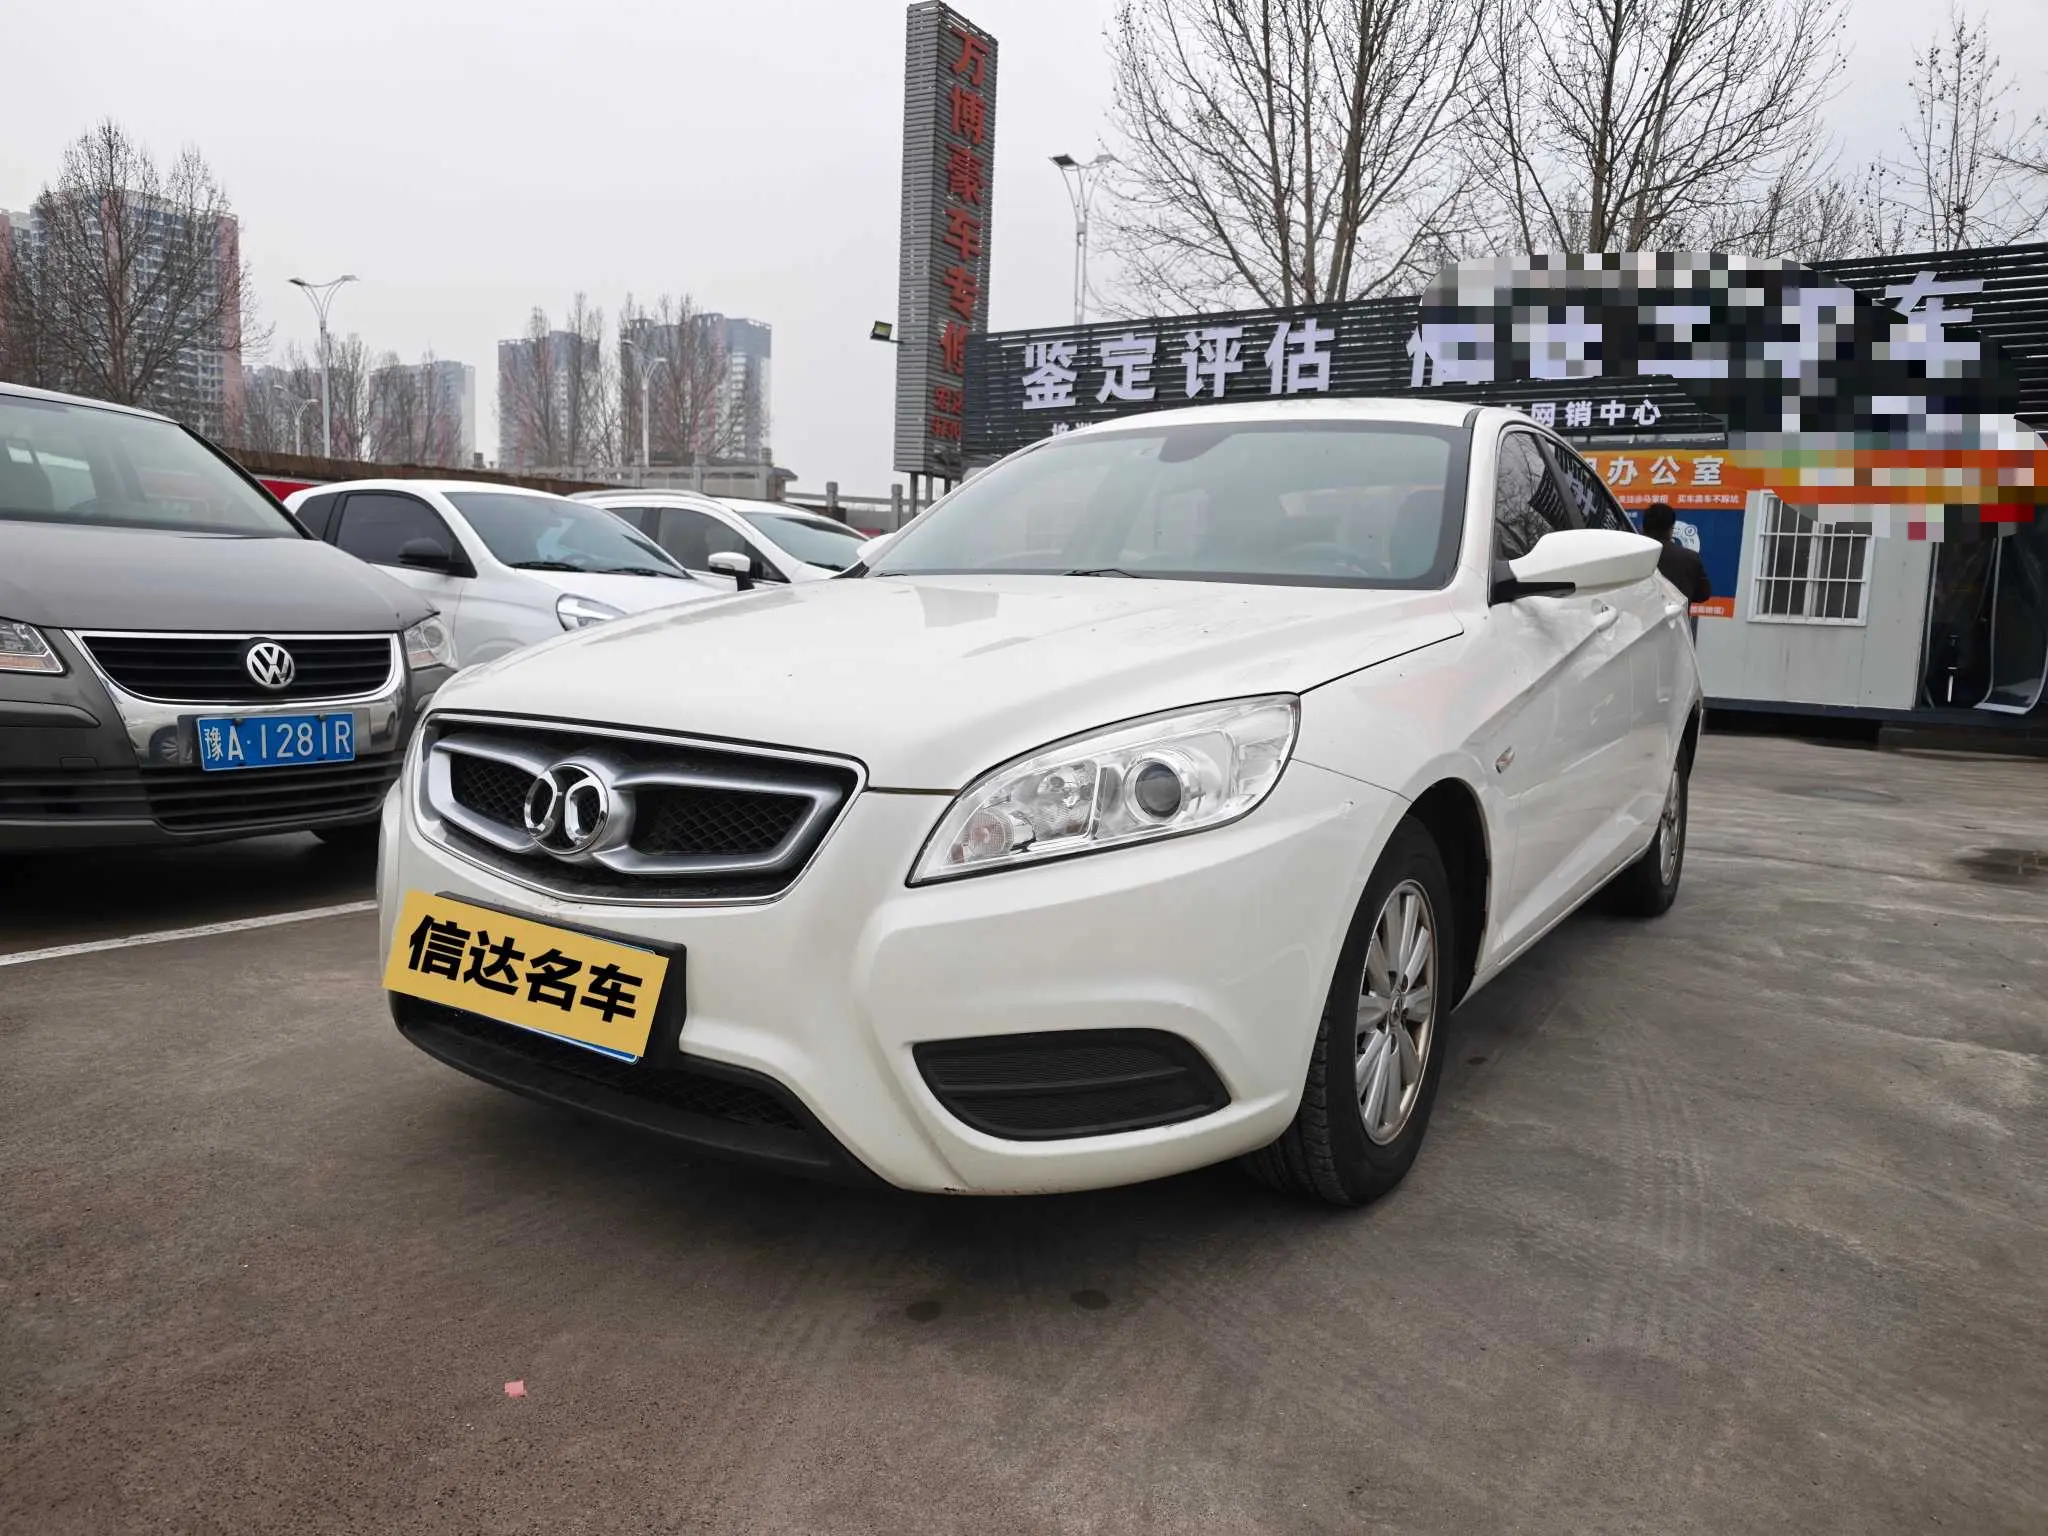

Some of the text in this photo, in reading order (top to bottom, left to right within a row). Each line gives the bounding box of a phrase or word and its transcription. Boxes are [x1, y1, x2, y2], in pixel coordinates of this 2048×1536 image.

[1022, 318, 1335, 410] 鉴定评估
[1505, 399, 1662, 428] 网销中心
